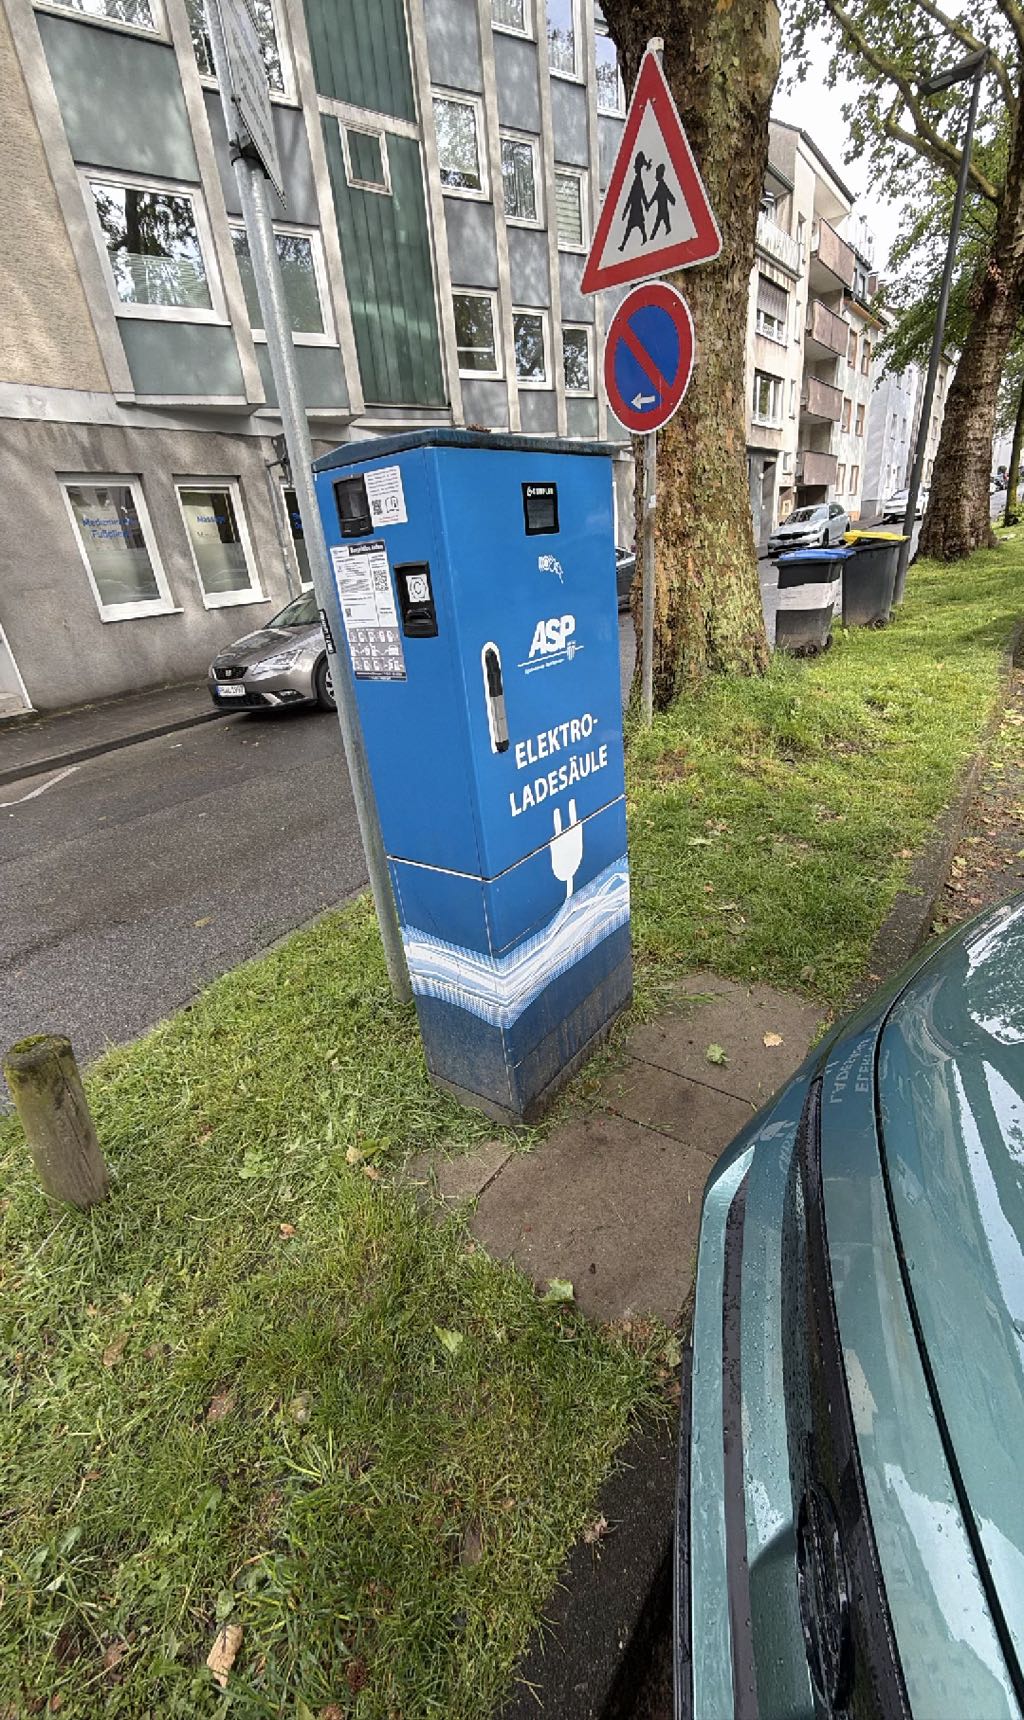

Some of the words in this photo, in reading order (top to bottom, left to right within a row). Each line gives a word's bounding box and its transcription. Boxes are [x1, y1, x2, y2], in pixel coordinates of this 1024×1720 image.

[528, 614, 576, 658] ASP
[515, 713, 598, 770] ELEKTRO-
[509, 744, 608, 817] LADESÄULE
